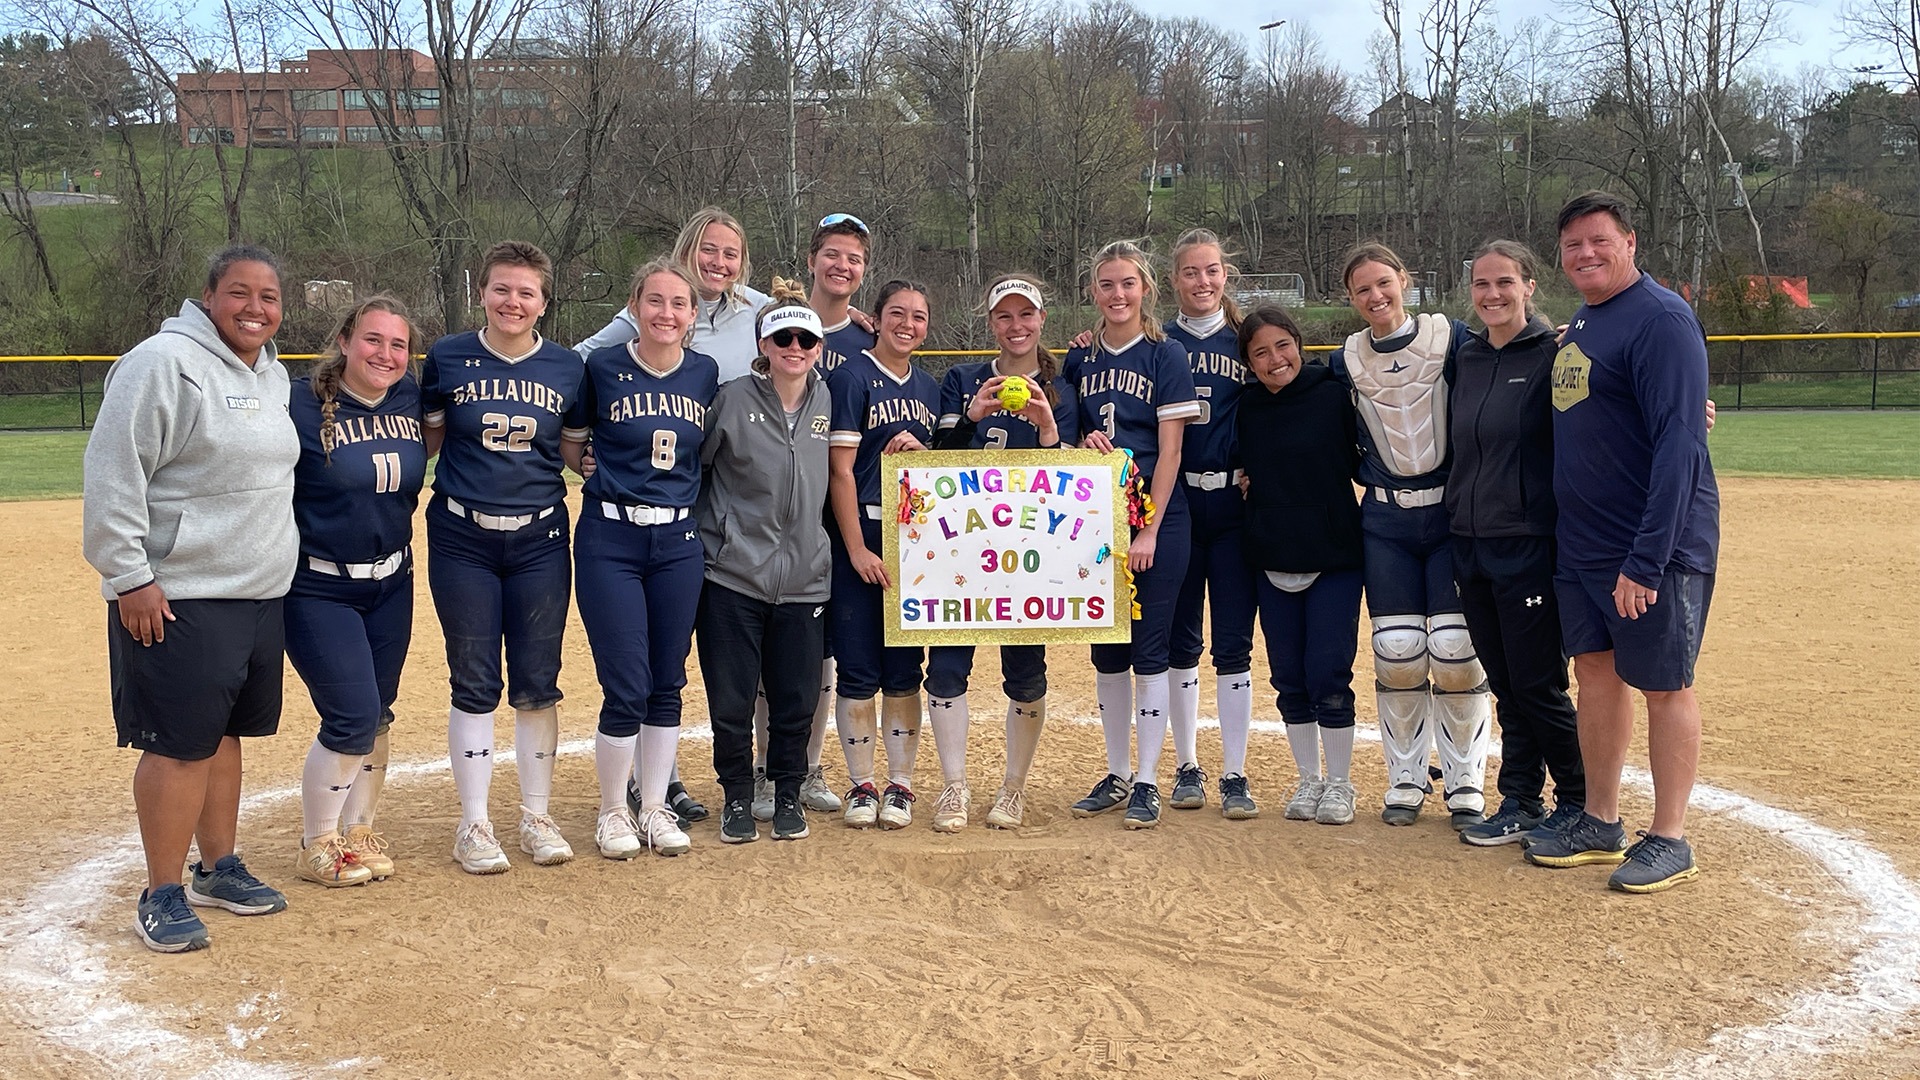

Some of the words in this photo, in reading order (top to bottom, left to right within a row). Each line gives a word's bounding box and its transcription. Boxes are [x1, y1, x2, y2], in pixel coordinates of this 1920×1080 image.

[995, 282, 1033, 295] GALLAUDET
[770, 310, 812, 323] GALLAUDET
[1080, 368, 1154, 404] ALLAUDET
[1187, 352, 1247, 385] LAUDET
[226, 396, 261, 411] BISON
[452, 378, 564, 416] GALLAUDET
[609, 392, 706, 433] GALLAUDET
[482, 412, 538, 452] 22
[984, 427, 1008, 450] 2
[1099, 402, 1116, 440] 3
[651, 429, 678, 471] 8
[371, 452, 401, 493] 11
[934, 468, 1095, 502] ONGRATS
[938, 503, 1084, 541] LACEY!
[980, 549, 1041, 573] 300
[902, 597, 1013, 623] STRIKE
[1023, 596, 1105, 621] OUTS
